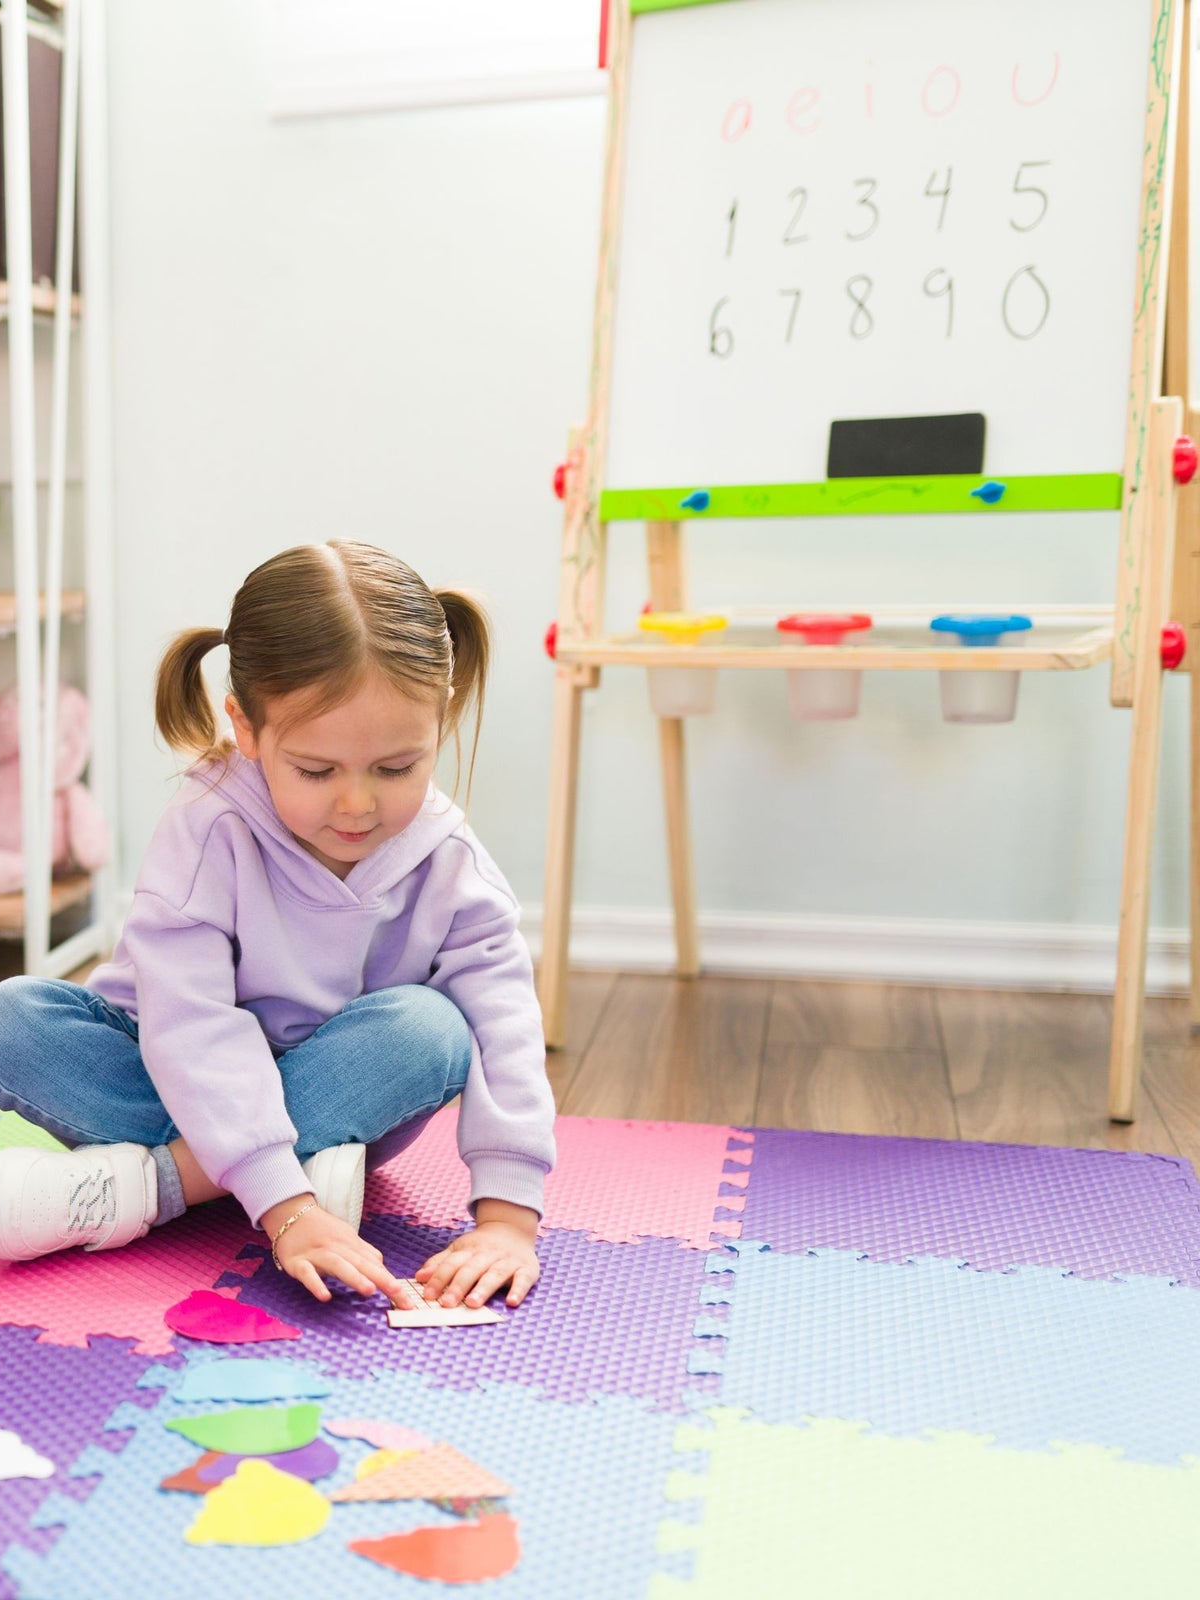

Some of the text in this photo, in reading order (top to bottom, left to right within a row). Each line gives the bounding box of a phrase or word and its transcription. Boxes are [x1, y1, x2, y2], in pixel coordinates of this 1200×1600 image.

[721, 100, 752, 142] a
[786, 86, 821, 134] e
[725, 160, 1050, 257] 1 2 3 4 5
[708, 264, 1051, 359] 6 7 8 9 0
